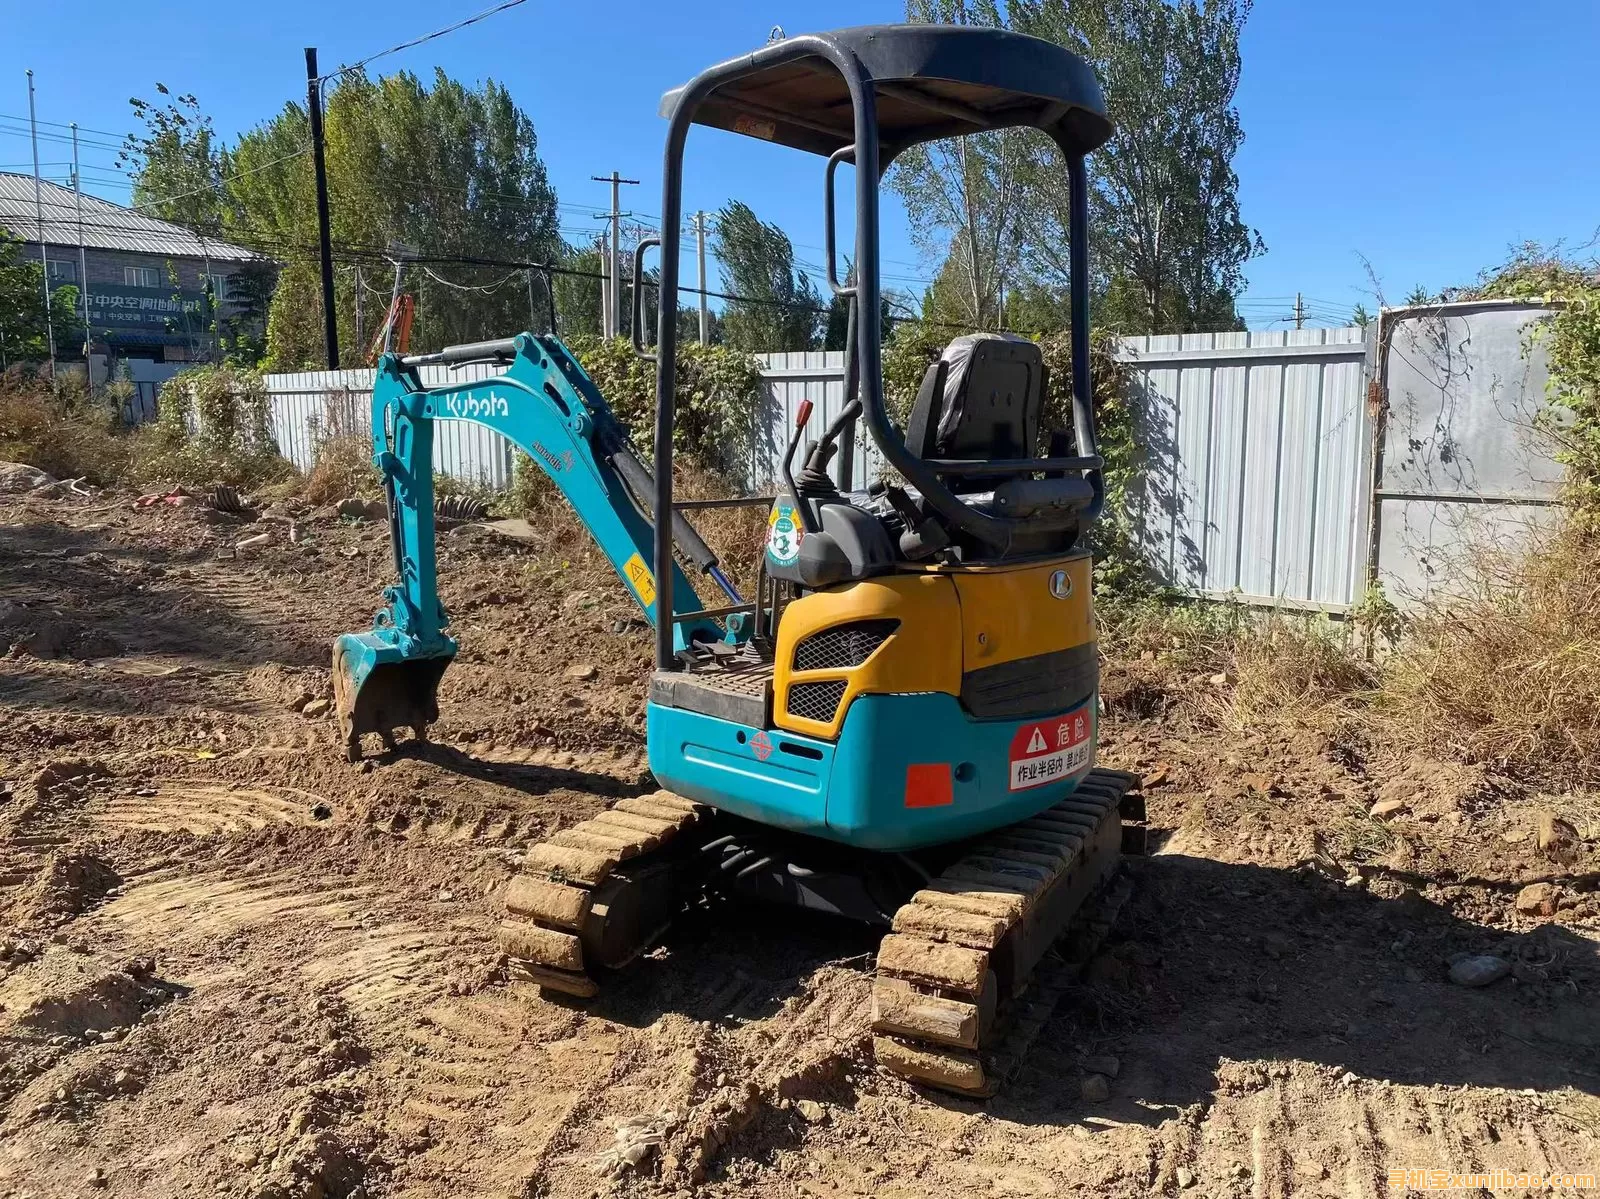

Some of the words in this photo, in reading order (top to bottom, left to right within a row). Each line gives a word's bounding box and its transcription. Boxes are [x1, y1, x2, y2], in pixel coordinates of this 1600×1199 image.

[446, 391, 509, 417] Kubota
[1057, 715, 1085, 747] 危险
[1018, 755, 1063, 782] 作业半径内
